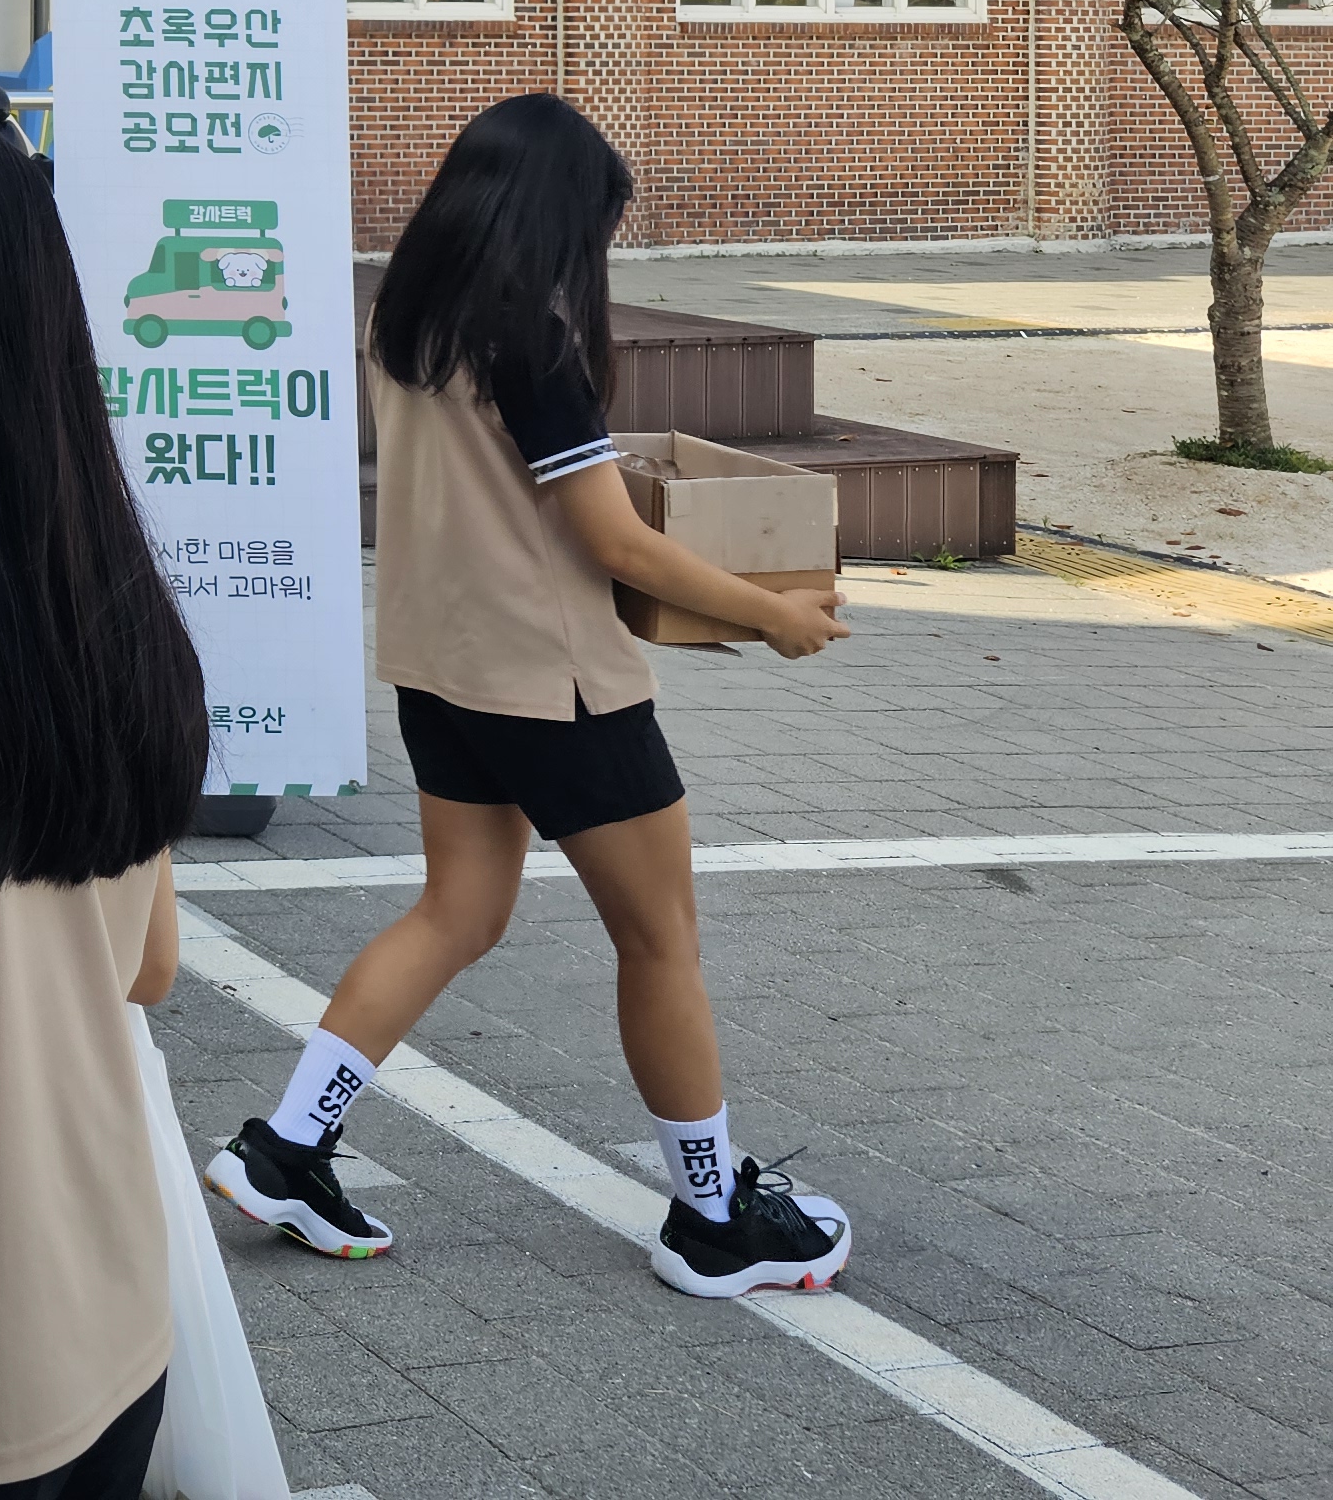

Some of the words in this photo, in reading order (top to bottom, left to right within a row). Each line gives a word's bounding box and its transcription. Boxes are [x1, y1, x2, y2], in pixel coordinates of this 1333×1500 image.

[119, 6, 282, 49] 초록우산
[119, 59, 283, 101] 감사편지
[121, 111, 242, 154] 공모전
[188, 205, 252, 224] 감사트럭
[144, 432, 276, 486] 왔다!!
[159, 538, 210, 565] 사한
[218, 539, 295, 566] 마음을
[227, 575, 312, 601] 고마워!
[210, 705, 286, 734] 록우산
[308, 1063, 363, 1131] BEST
[678, 1136, 723, 1199] BEST
